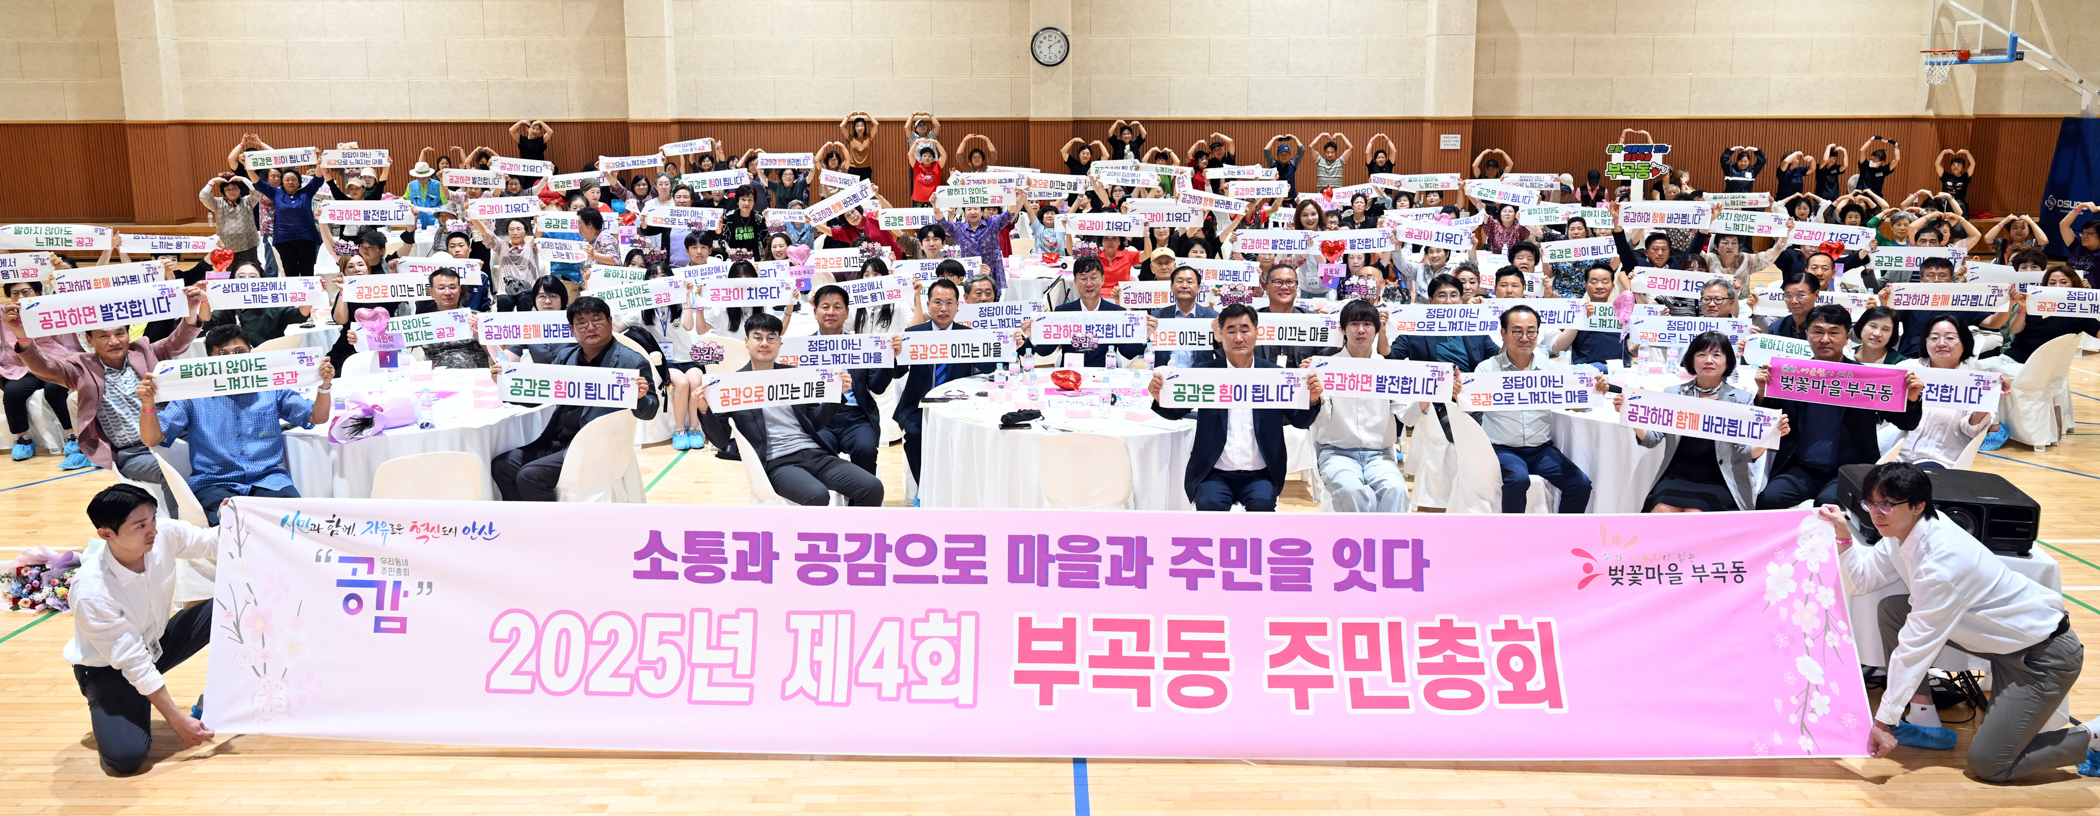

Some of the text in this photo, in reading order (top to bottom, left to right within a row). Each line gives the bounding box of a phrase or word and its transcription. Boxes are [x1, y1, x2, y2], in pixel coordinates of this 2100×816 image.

[252, 154, 310, 167] 공감은 힘이 됩니다
[500, 162, 542, 174] 공감이 치유다
[1607, 163, 1650, 178] 부곡동
[947, 186, 988, 195] 말하지 않아도
[1234, 186, 1282, 196] 공감하면 발전합니다
[1477, 187, 1531, 204] 공감은 힘이 됩니다
[962, 195, 1003, 205] 느껴지는 공감
[478, 203, 530, 214] 공감이 치유다
[328, 209, 404, 222] 공감하면 발전합니다
[1623, 212, 1701, 225] 공감하며 함께 바라봅니다
[1078, 220, 1132, 232] 공감이 치유다
[1725, 223, 1772, 234] 느껴지는 공감
[36, 237, 94, 247] 느껴지는 공감
[1241, 238, 1308, 250] 공감하면 발전합니다
[1350, 238, 1387, 250] 발전합니다
[1405, 229, 1463, 246] 공감이 치유다
[1794, 230, 1860, 245] 공감이 치유다
[151, 241, 206, 250] 느끼는 용기 공감
[1549, 245, 1614, 259] 공감은 힘이 됩니다
[1, 268, 38, 280] 용기 공감
[1205, 269, 1251, 282] 함께 바라봅니다
[222, 281, 287, 293] 상대의 입장에서
[356, 285, 389, 299] 공감으로
[390, 284, 415, 298] 이끄는
[597, 284, 650, 301] 말하지 않아도
[243, 292, 306, 304] 느끼는 용기 공감
[710, 286, 780, 302] 공감이 치유다
[1894, 294, 1998, 307] 공감하며 함께 바라봅니다
[2066, 290, 2098, 302] 정답이
[618, 292, 671, 310] 느껴지는 공감
[38, 296, 171, 330] 공감하면 발전합니다
[979, 305, 1022, 318] 정답이 아닌
[1426, 308, 1480, 319] 정답이 아닌
[402, 317, 432, 331] 않아도
[990, 318, 1022, 329] 느껴지는
[1396, 321, 1498, 332] 공감으로 느껴지는 마을
[1667, 320, 1719, 332] 정답이 아닌
[436, 327, 455, 339] 공감
[1042, 324, 1082, 340] 공감하면
[808, 339, 861, 352] 정답이 아닌
[1760, 337, 1784, 350] 말하지
[909, 342, 1002, 361] 공감으로 이끄는 마을
[821, 354, 860, 366] 느껴지는
[863, 352, 882, 365] 마을
[179, 357, 267, 378] 말하지 않아도
[213, 371, 299, 392] 느껴지는 공감
[1323, 372, 1438, 396] 공감하면 발전합니다
[1502, 375, 1564, 389] 정답이 아닌
[510, 378, 624, 402] 공감은 힘이 됩니다
[720, 381, 826, 407] 공감으로 이끄는 마을
[1173, 384, 1294, 403] 공감은 힘이 됩니다
[1780, 375, 1894, 402] 벚꽃마을 부곡동
[1470, 390, 1588, 406] 공감으로 느껴지는 마을
[1627, 404, 1764, 440] 공감하며 함께 바라봅니다
[280, 511, 323, 540] 시민과
[360, 520, 404, 545] 자유로운
[409, 521, 458, 545] 혁신도시
[462, 521, 501, 541] 안산
[380, 557, 409, 566] 우리동네
[632, 530, 1431, 592] 소통과 공감으로 마을과 주민을 잇다
[380, 567, 410, 577] 주민총회
[1608, 560, 1747, 586] 벚꽃마을 부곡동
[485, 607, 1569, 715] 2025년 제4회 부곡동 주민총회
